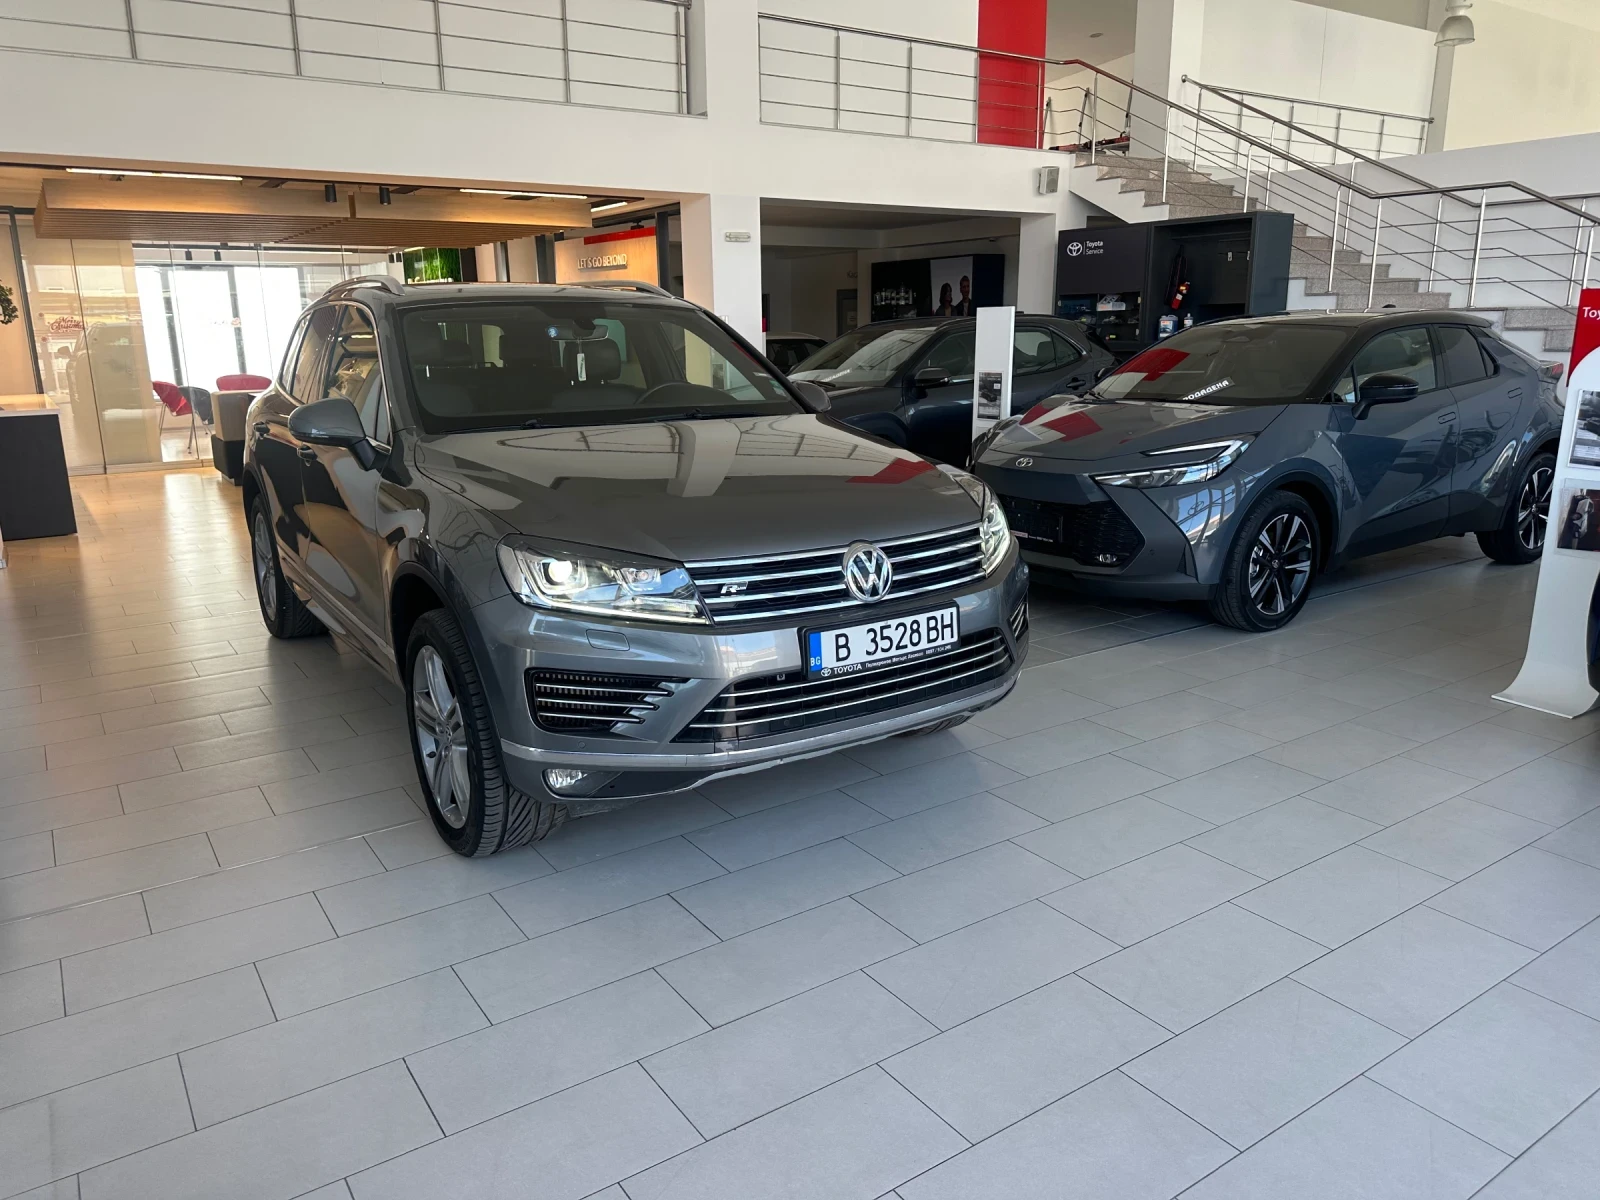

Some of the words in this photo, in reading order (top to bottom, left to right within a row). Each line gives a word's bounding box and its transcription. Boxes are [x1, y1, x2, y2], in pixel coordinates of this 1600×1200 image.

[1086, 240, 1103, 248] Toyota
[593, 257, 602, 268] GO
[602, 253, 627, 267] BEYOND
[835, 632, 851, 662] B
[865, 619, 922, 656] 3528
[926, 611, 954, 644] BH
[810, 656, 821, 667] BG
[833, 663, 862, 675] TOYOTA
